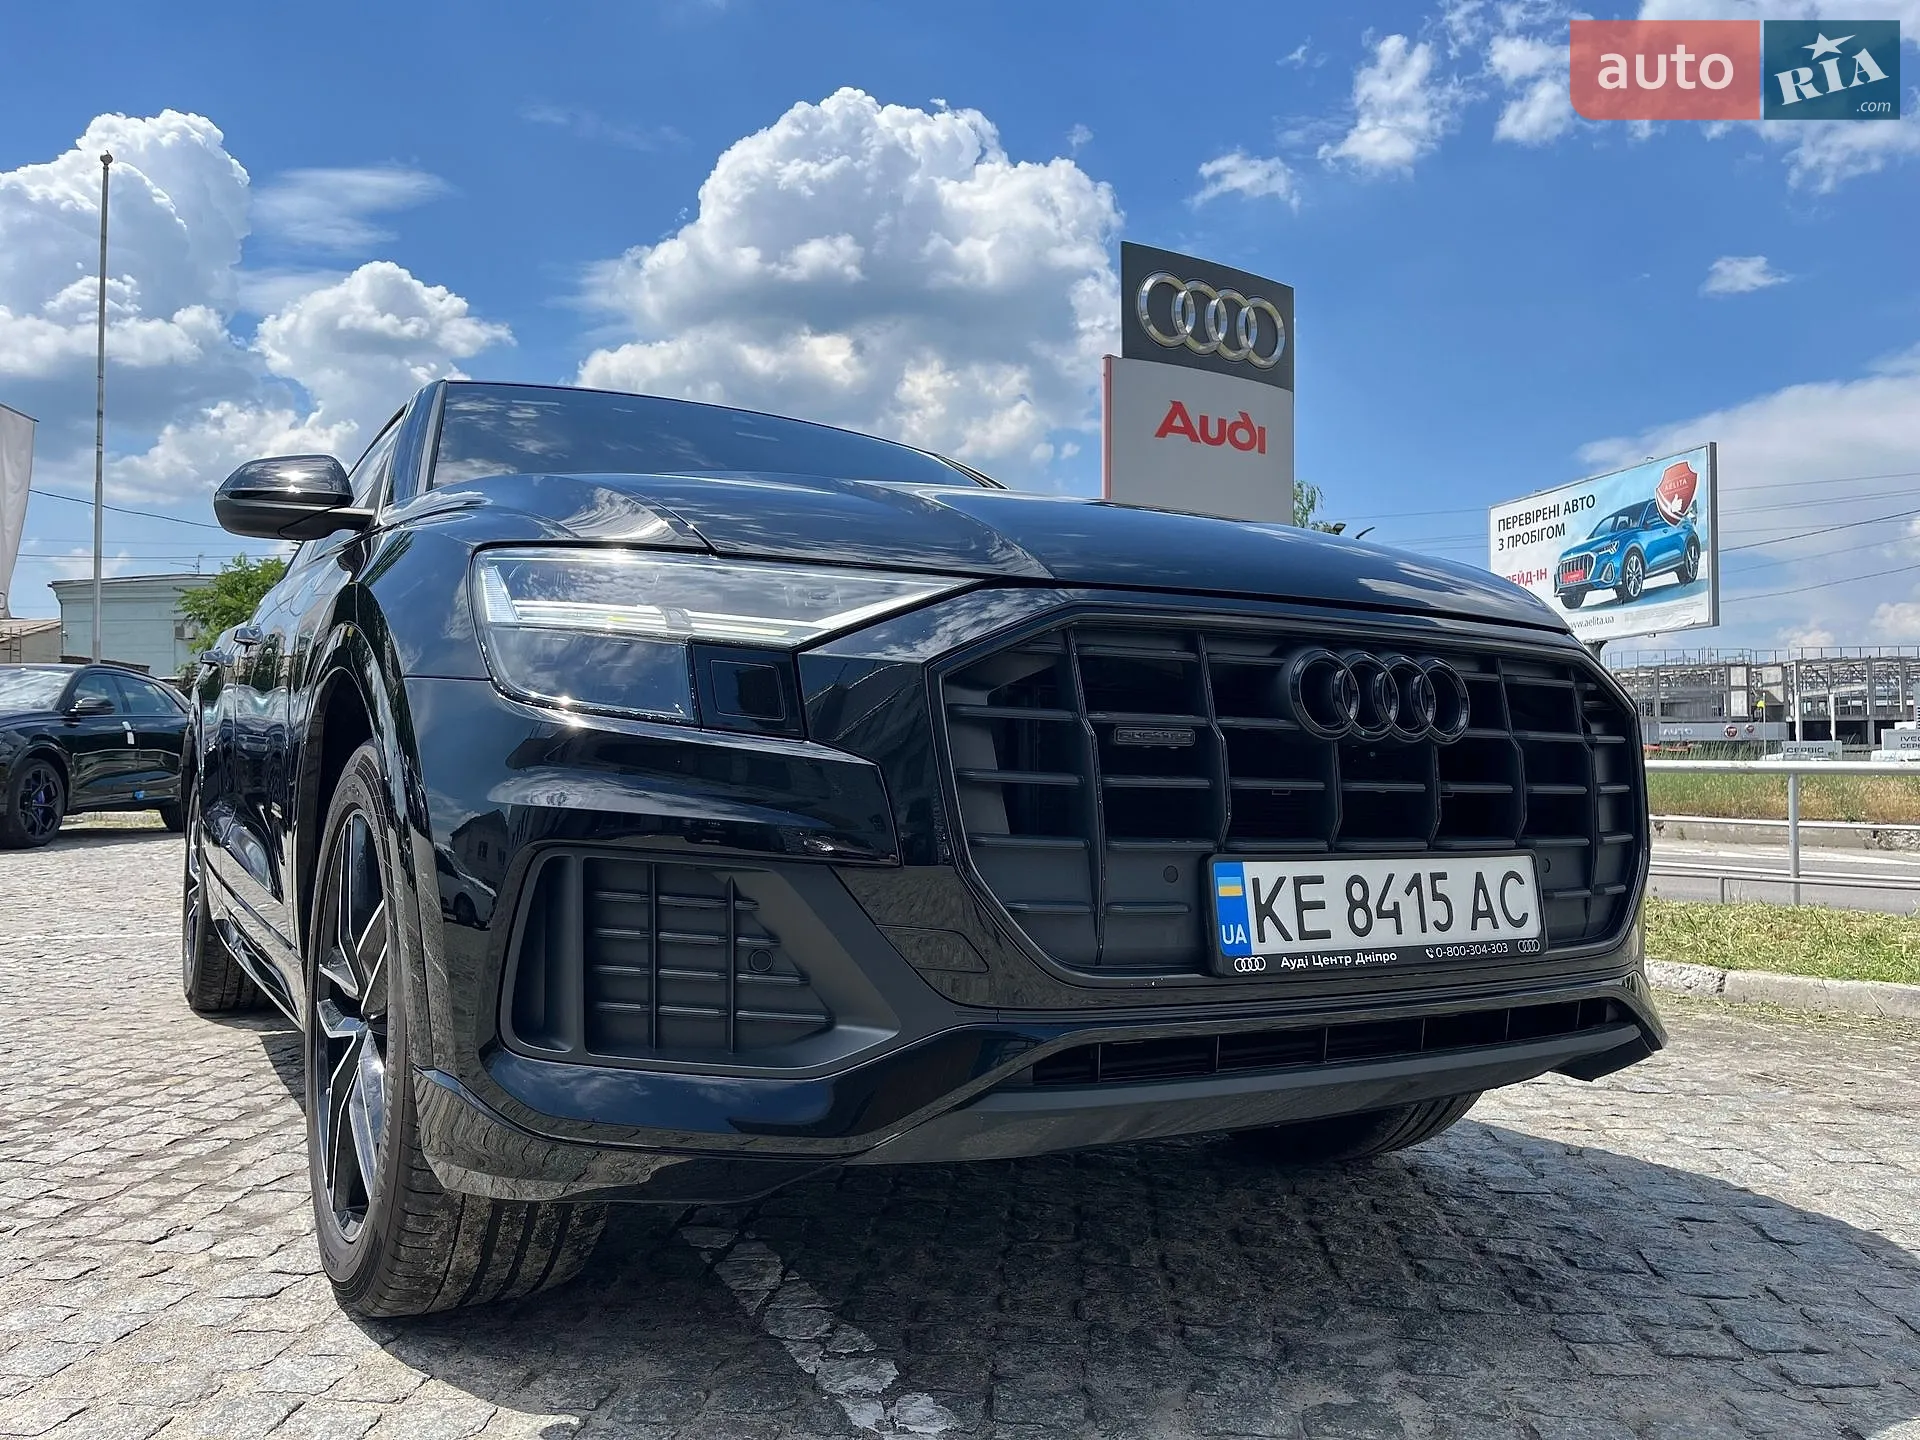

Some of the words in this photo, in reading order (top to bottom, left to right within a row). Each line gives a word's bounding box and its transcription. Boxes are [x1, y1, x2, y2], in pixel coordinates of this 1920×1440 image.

[1155, 400, 1266, 454] Audi
[1498, 503, 1560, 532] ПЕРЕВІРЕНІ
[1563, 494, 1595, 515] АВТО
[1507, 522, 1566, 549] ПРОБІГОМ
[1252, 874, 1332, 944] KE
[1345, 871, 1454, 938] 8415
[1471, 869, 1529, 931] AC
[1220, 923, 1247, 945] UA
[1280, 955, 1309, 970] Ауді
[1312, 954, 1352, 968] Центр
[1355, 951, 1397, 965] Дніпро
[1435, 942, 1508, 958] 0-800-304-303
